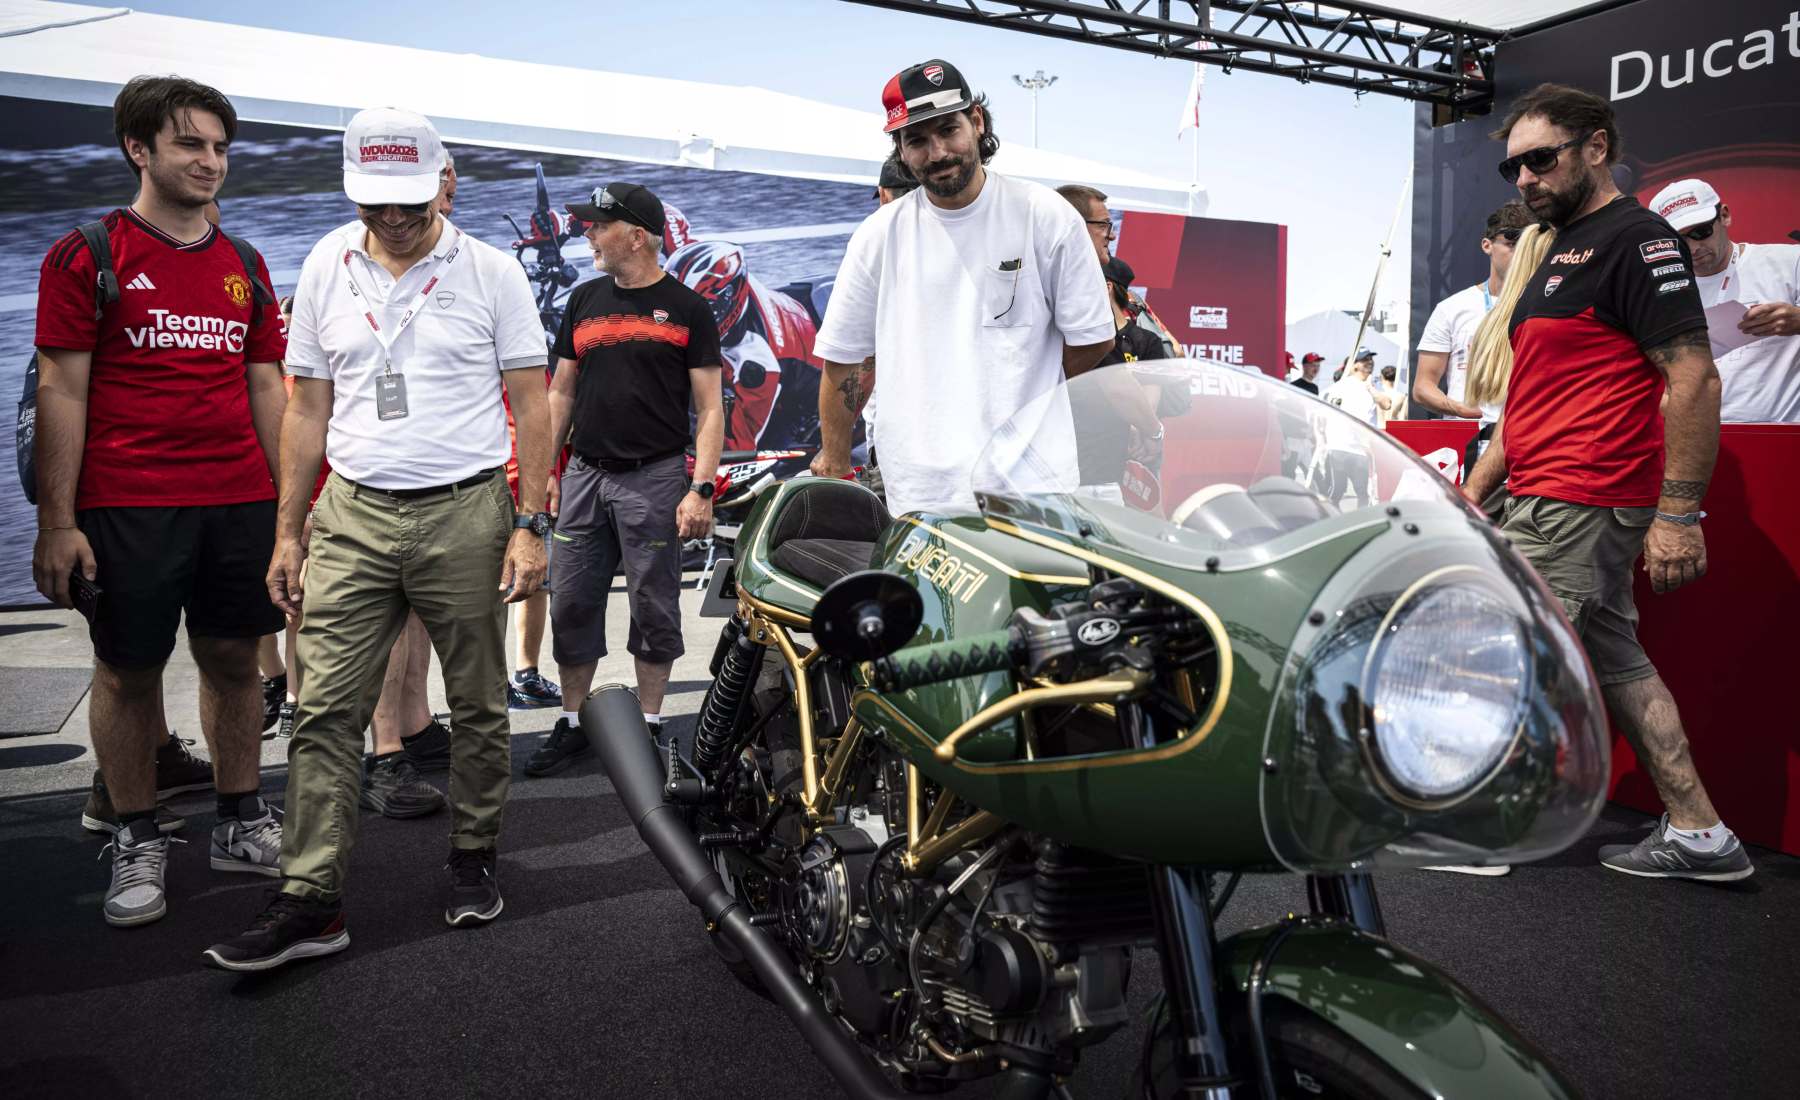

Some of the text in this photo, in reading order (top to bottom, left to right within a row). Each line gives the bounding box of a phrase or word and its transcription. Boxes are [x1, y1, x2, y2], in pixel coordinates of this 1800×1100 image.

[1610, 11, 1800, 101] Ducat
[360, 145, 418, 156] WDW2026
[147, 309, 225, 334] Team
[124, 326, 224, 350] Viewer
[1208, 344, 1244, 364] THE
[1190, 372, 1259, 399] GEND
[895, 535, 990, 604] DUCATI
